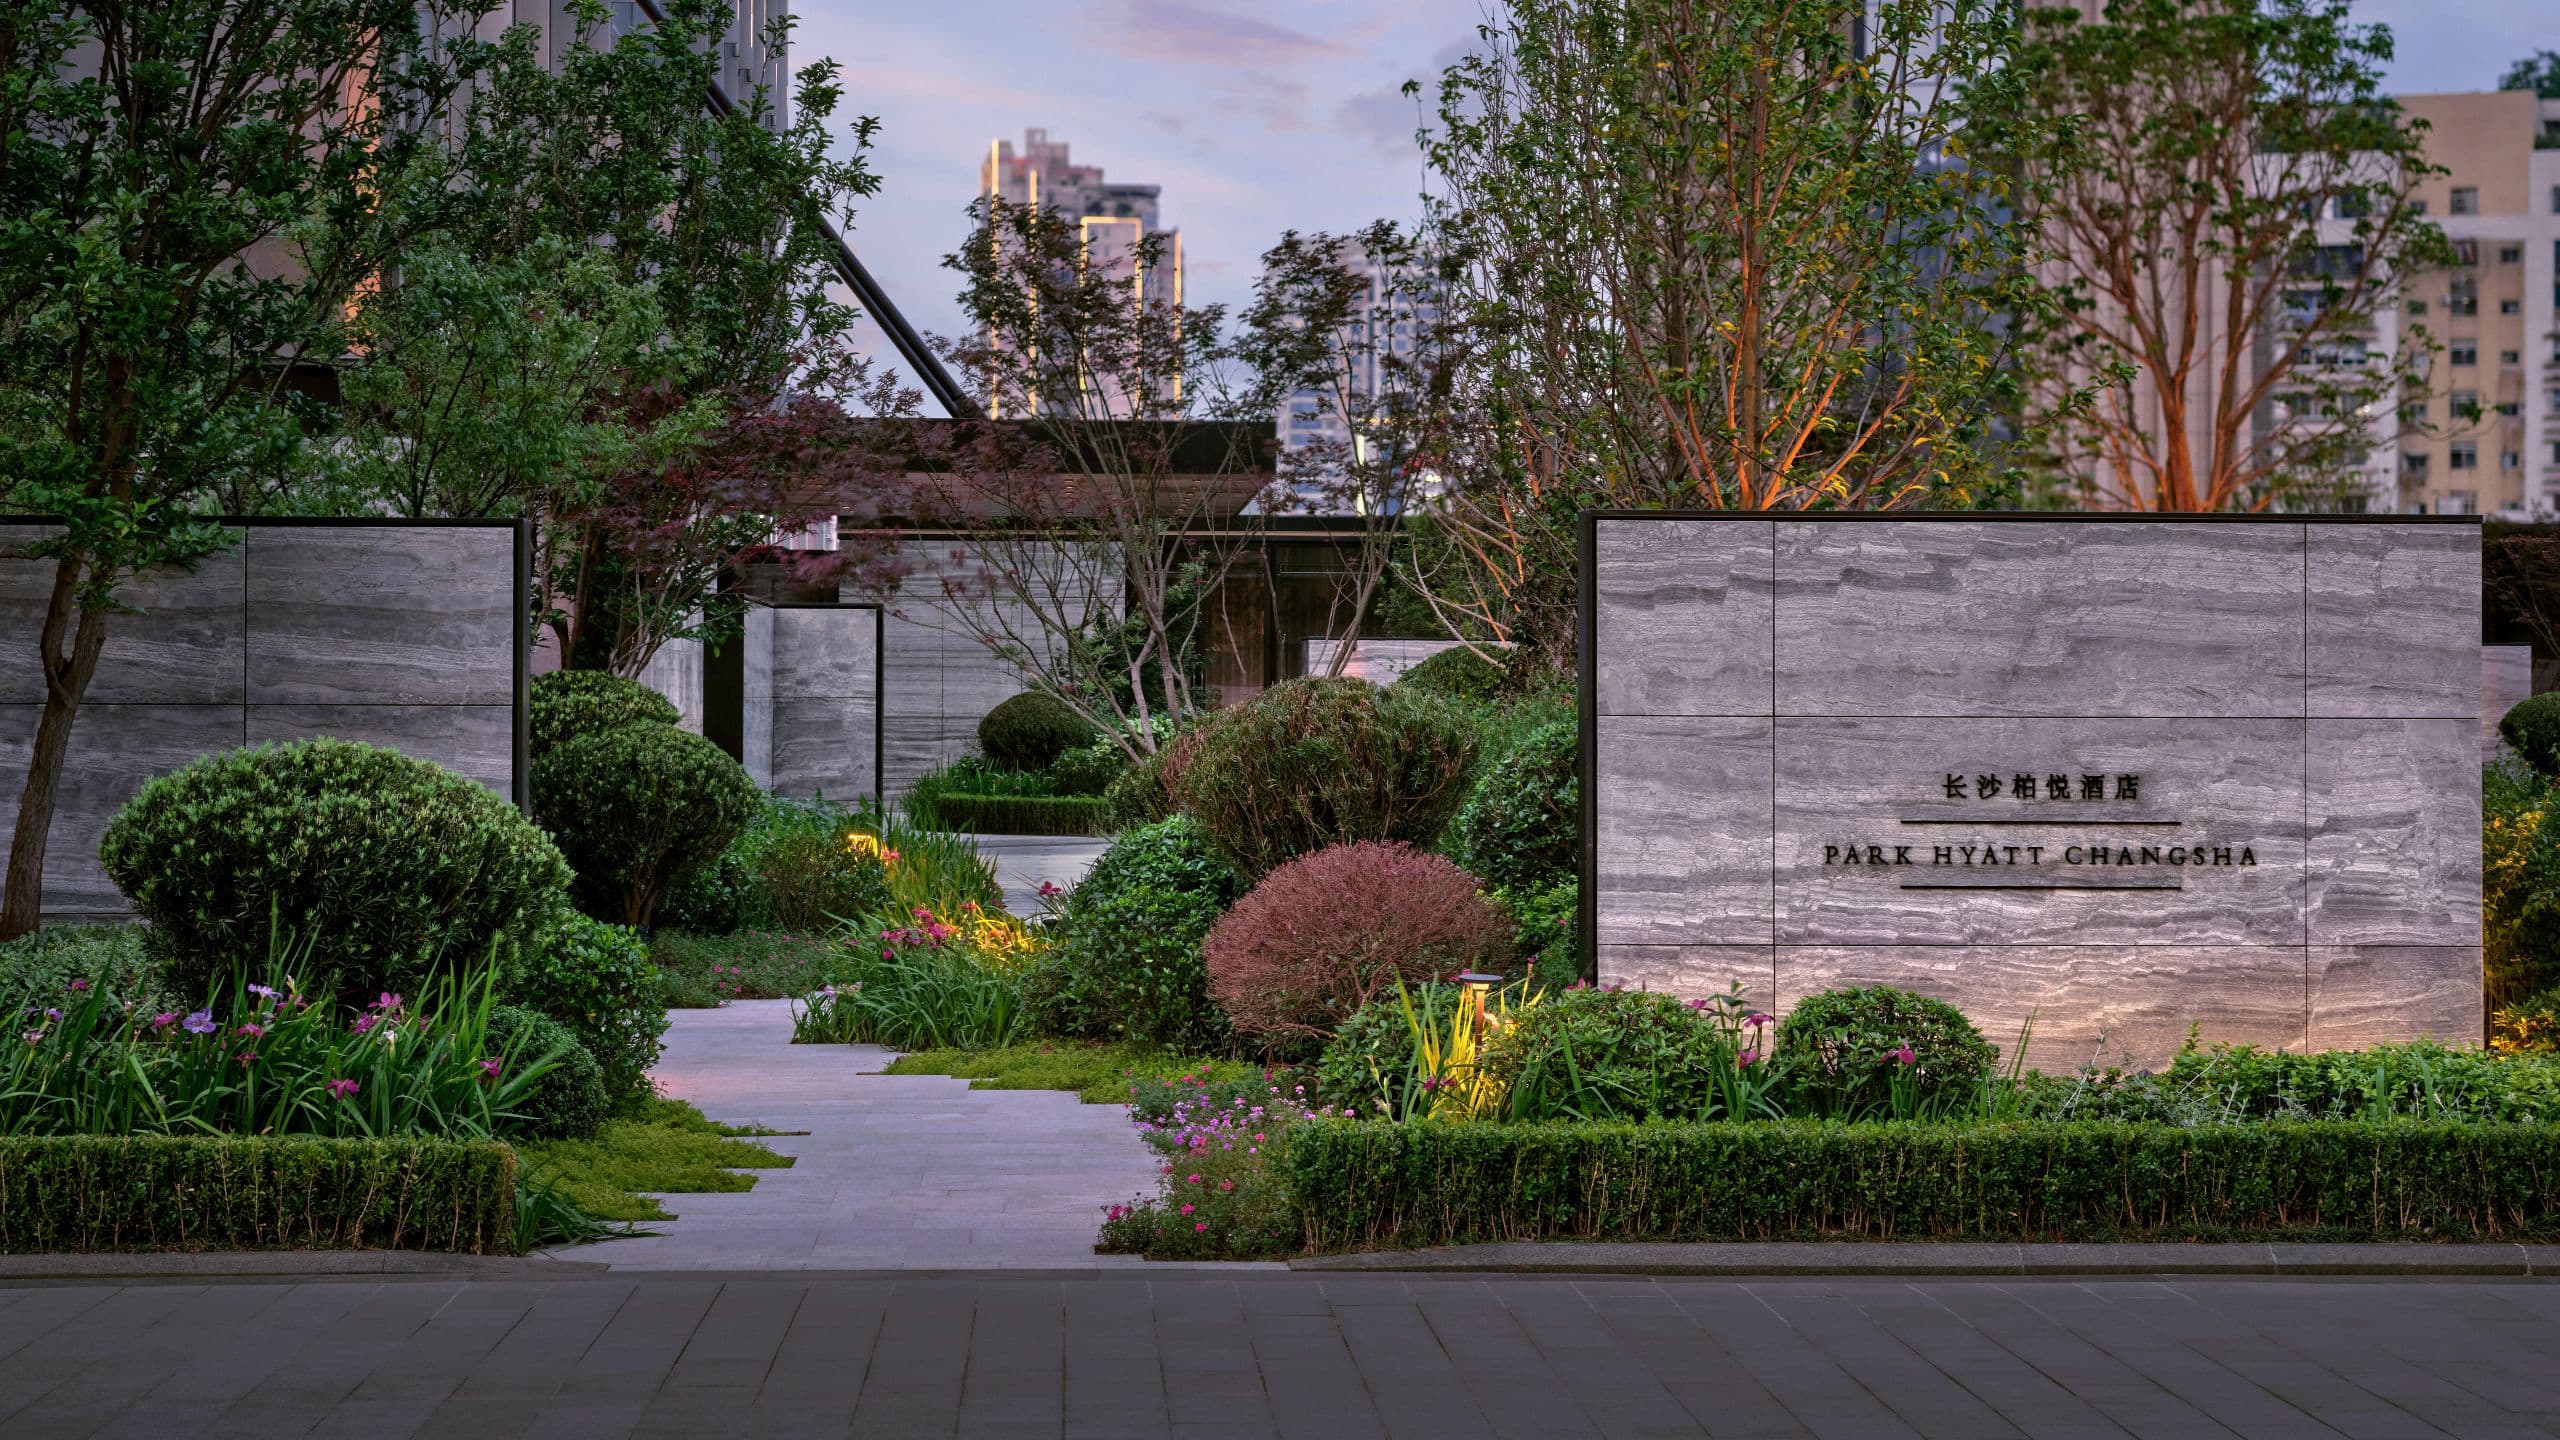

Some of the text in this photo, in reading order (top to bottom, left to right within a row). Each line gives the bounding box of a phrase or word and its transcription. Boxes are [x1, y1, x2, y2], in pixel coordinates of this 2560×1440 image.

[1942, 773, 2140, 801] 长沙柏悦酒店
[1824, 845, 2258, 867] PARK HYATT CHANGSHA
